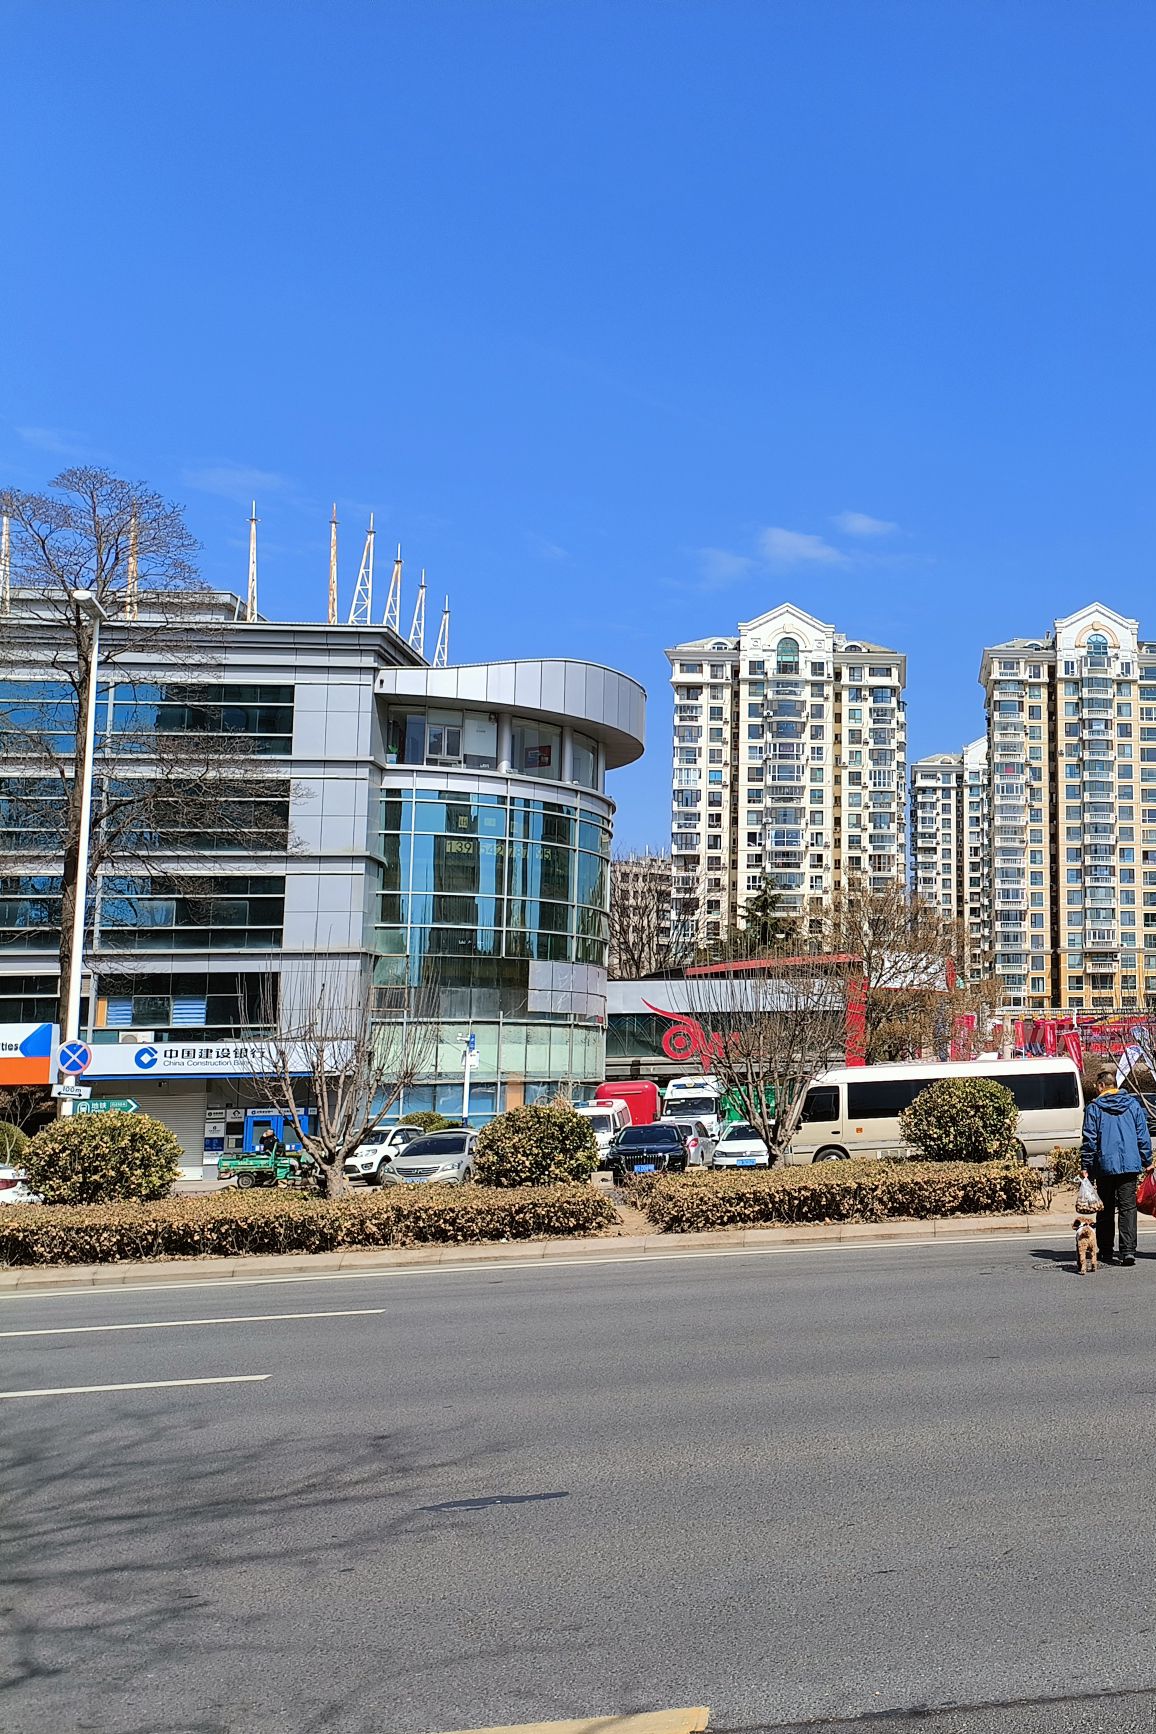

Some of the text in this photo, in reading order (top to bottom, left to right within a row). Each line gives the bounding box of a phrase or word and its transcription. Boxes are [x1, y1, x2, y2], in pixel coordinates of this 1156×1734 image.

[0, 1042, 19, 1052] ties
[163, 1048, 266, 1060] 中国建设银行
